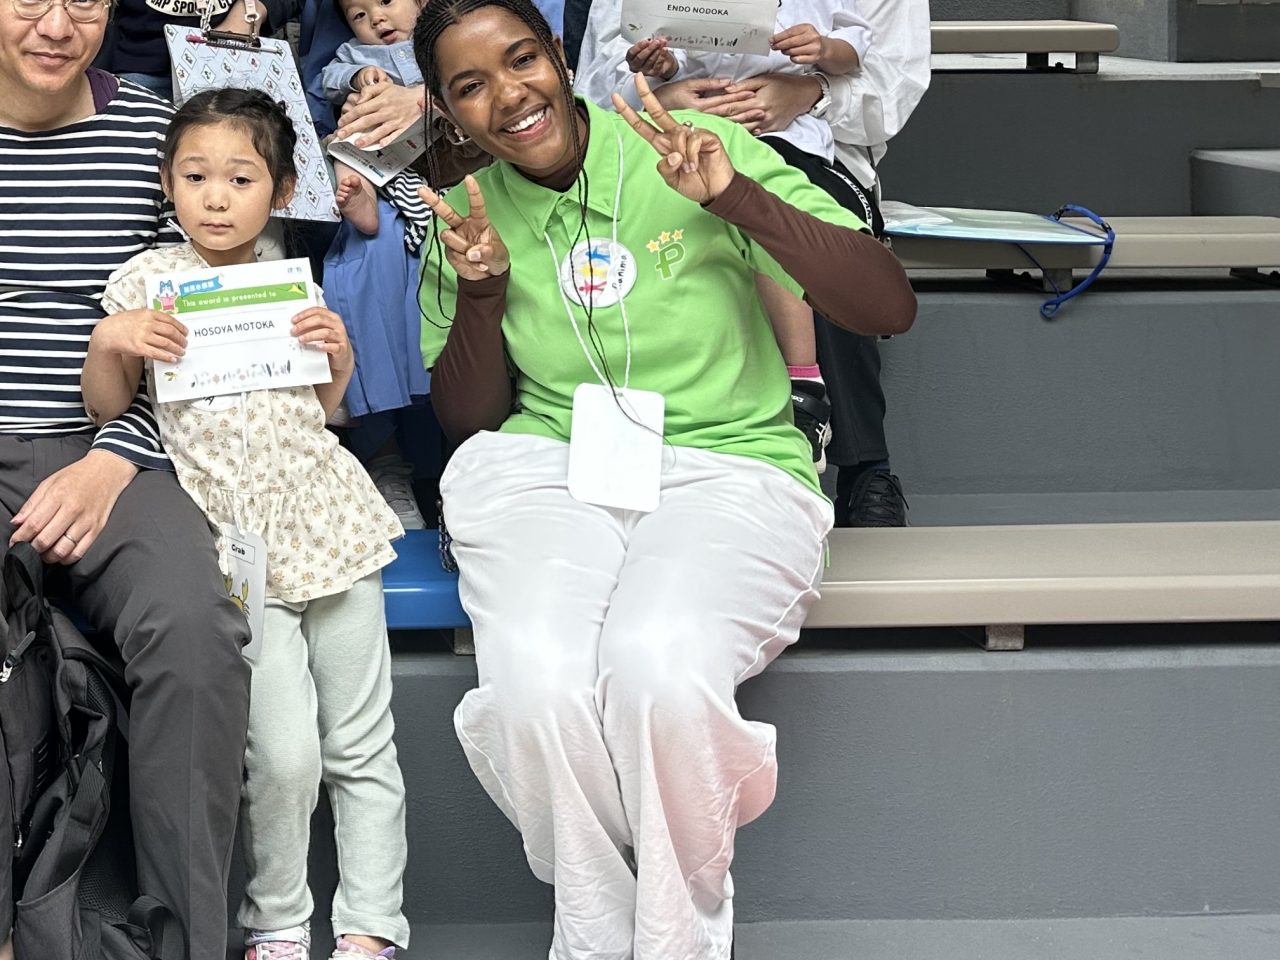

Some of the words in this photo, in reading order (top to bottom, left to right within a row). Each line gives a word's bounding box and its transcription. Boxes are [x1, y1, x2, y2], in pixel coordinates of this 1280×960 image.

[667, 4, 691, 12] ENDO
[692, 6, 729, 16] NODOKA
[182, 299, 196, 307] This
[198, 296, 220, 305] award
[231, 292, 267, 304] presented
[194, 324, 234, 338] HOSOYA
[234, 320, 276, 332] MOTOKA
[232, 544, 246, 556] Crab
